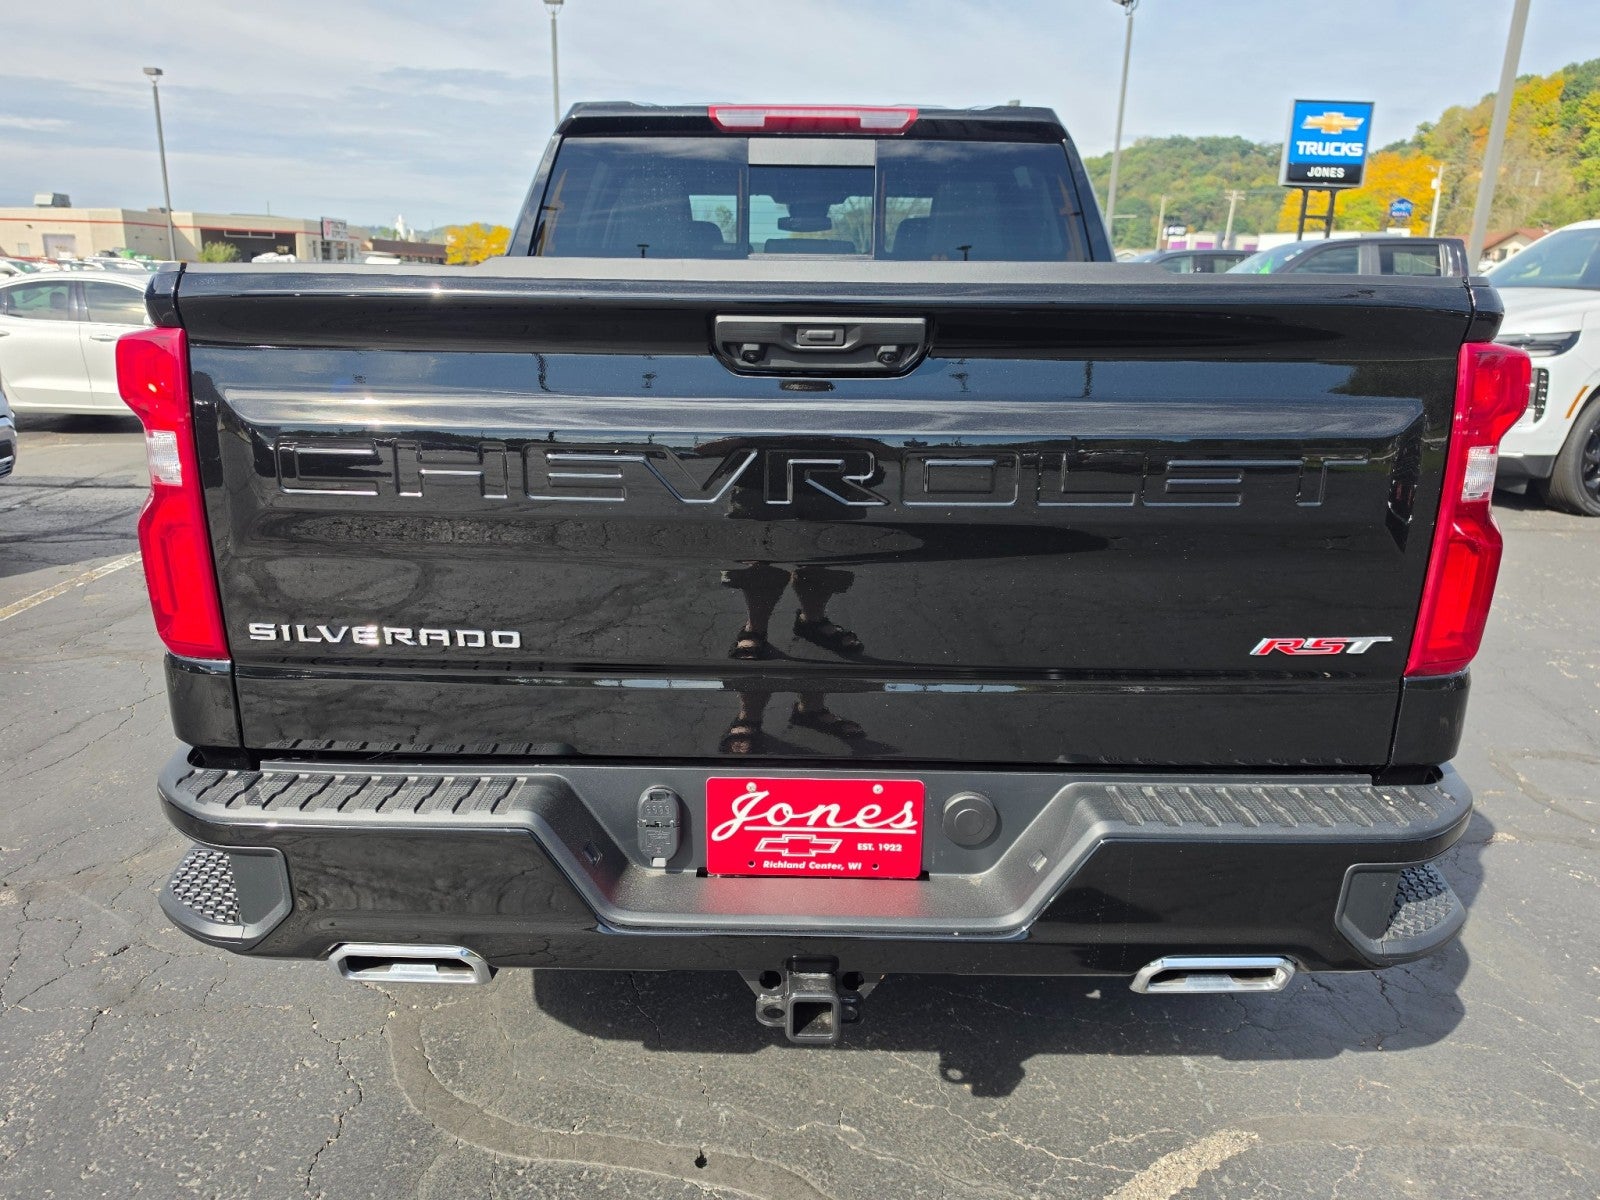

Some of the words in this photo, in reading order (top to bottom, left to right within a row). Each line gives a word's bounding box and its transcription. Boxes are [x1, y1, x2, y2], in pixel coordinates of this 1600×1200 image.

[1296, 141, 1364, 157] TRUCKS
[1306, 166, 1345, 178] JONES
[275, 437, 1370, 507] CHEVROLET
[249, 622, 521, 649] SILVERADO
[1250, 636, 1393, 656] RST
[711, 790, 918, 842] Jones
[857, 843, 875, 851] EST.
[878, 843, 902, 852] 1922
[763, 860, 805, 869] Richland
[809, 861, 844, 871] Center,
